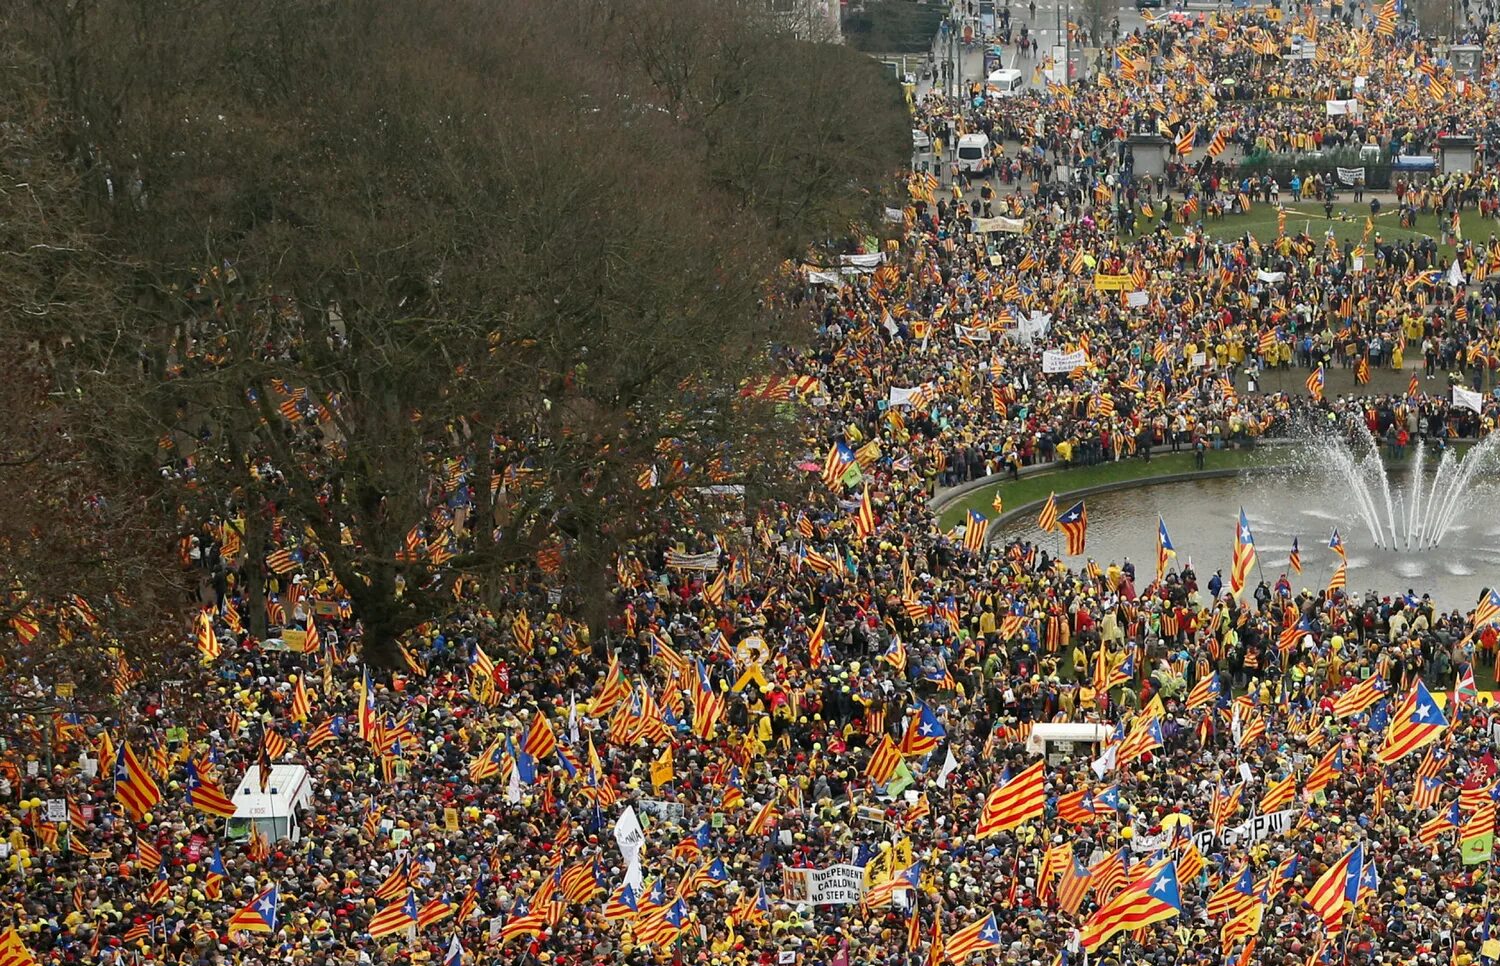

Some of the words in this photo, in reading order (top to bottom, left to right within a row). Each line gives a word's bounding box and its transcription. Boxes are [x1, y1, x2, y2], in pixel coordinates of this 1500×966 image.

[812, 868, 863, 881] INDEPENDENT
[812, 893, 824, 902] NO
[826, 890, 845, 900] STEP
